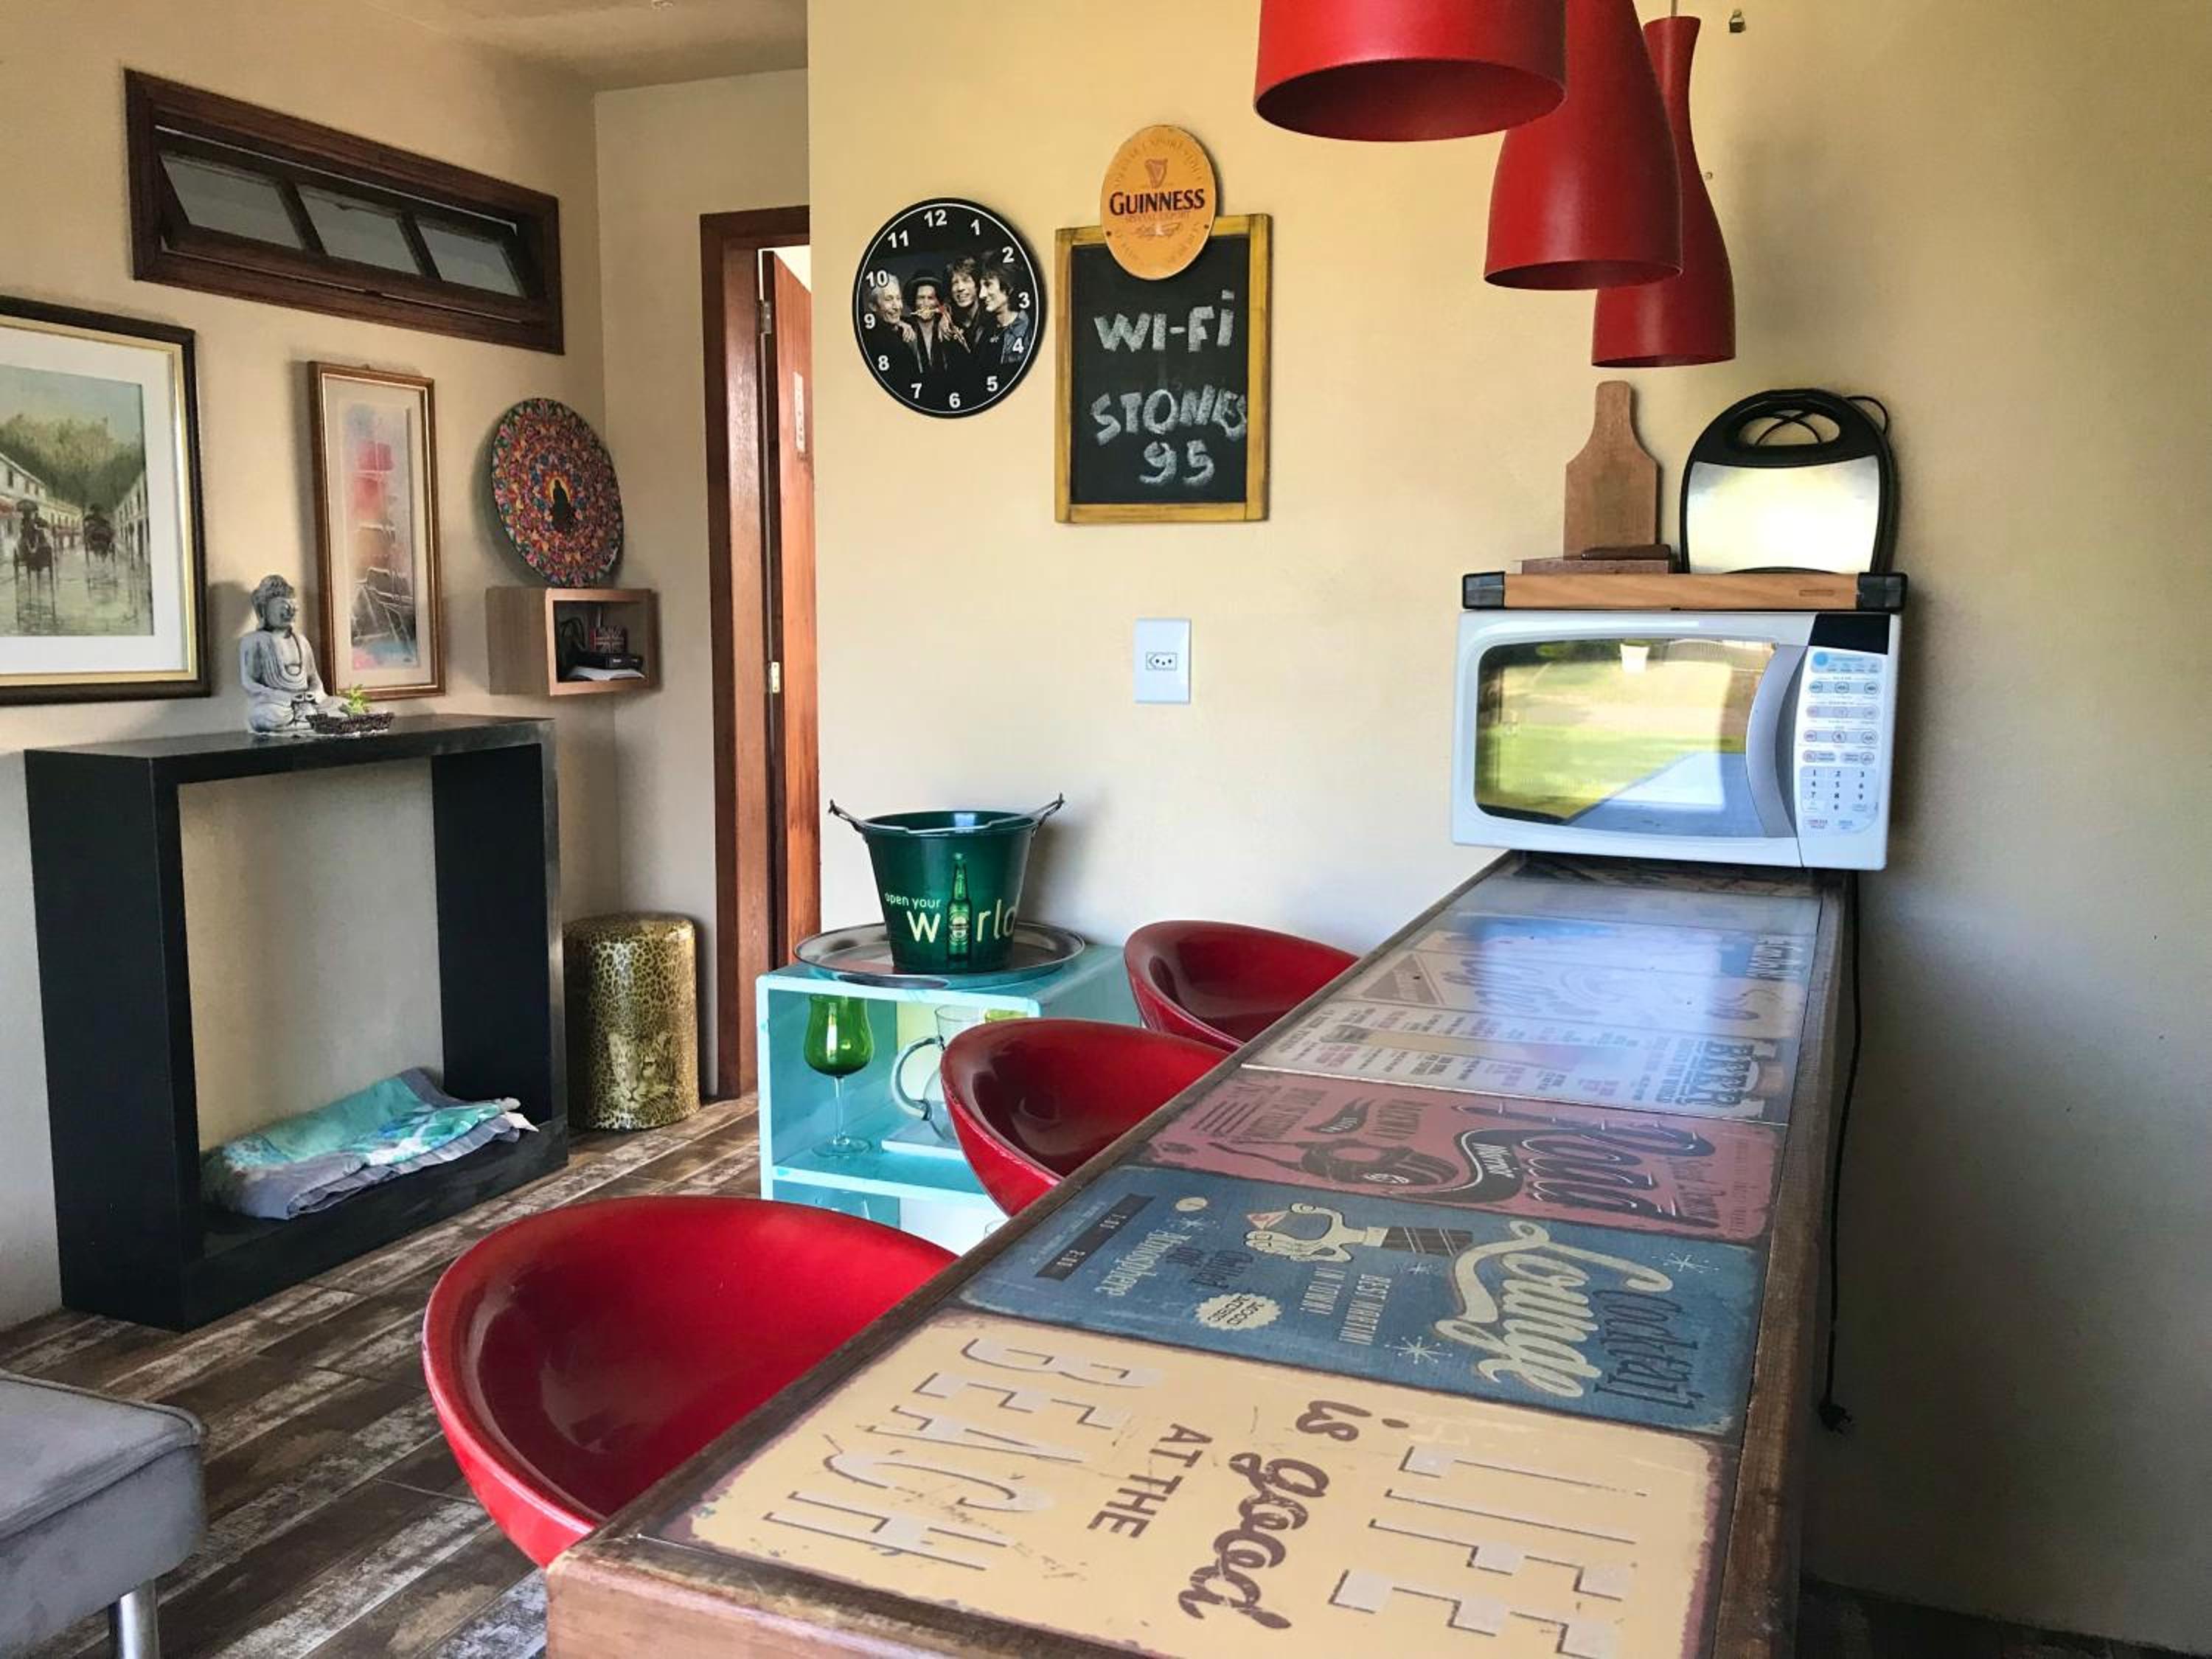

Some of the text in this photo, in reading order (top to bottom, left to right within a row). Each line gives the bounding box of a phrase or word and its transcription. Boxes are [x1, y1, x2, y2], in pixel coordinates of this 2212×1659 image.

[1110, 189, 1205, 216] GUINNESS
[924, 209, 947, 227] 12
[970, 219, 981, 235] 1
[887, 230, 909, 248] 11
[1002, 246, 1015, 263] 2
[866, 270, 888, 288] 10
[1018, 292, 1030, 309] 3
[863, 313, 876, 330] 9
[1012, 338, 1024, 353] 4
[877, 355, 889, 371] 8
[911, 383, 922, 399] 7
[987, 376, 998, 392] 5
[949, 392, 961, 408] 6
[1139, 439, 1215, 486] 95
[885, 893, 941, 911] open your
[1456, 1106, 1719, 1228] Road
[1094, 1229, 1192, 1297] Atmosphere
[1299, 1266, 1346, 1315] IN TOWN!
[1207, 1295, 1251, 1324] MUSIC
[1226, 1301, 1265, 1326] MOOD
[1338, 1273, 1392, 1346] BEST MARTINI
[1434, 1220, 1674, 1397] Lounge
[1592, 1290, 1705, 1409] Cocktail
[762, 1331, 1165, 1571] BEACH
[1086, 1423, 1214, 1539] AT THE
[1178, 1400, 1410, 1629] is good
[1328, 1442, 1650, 1659] LIFE
